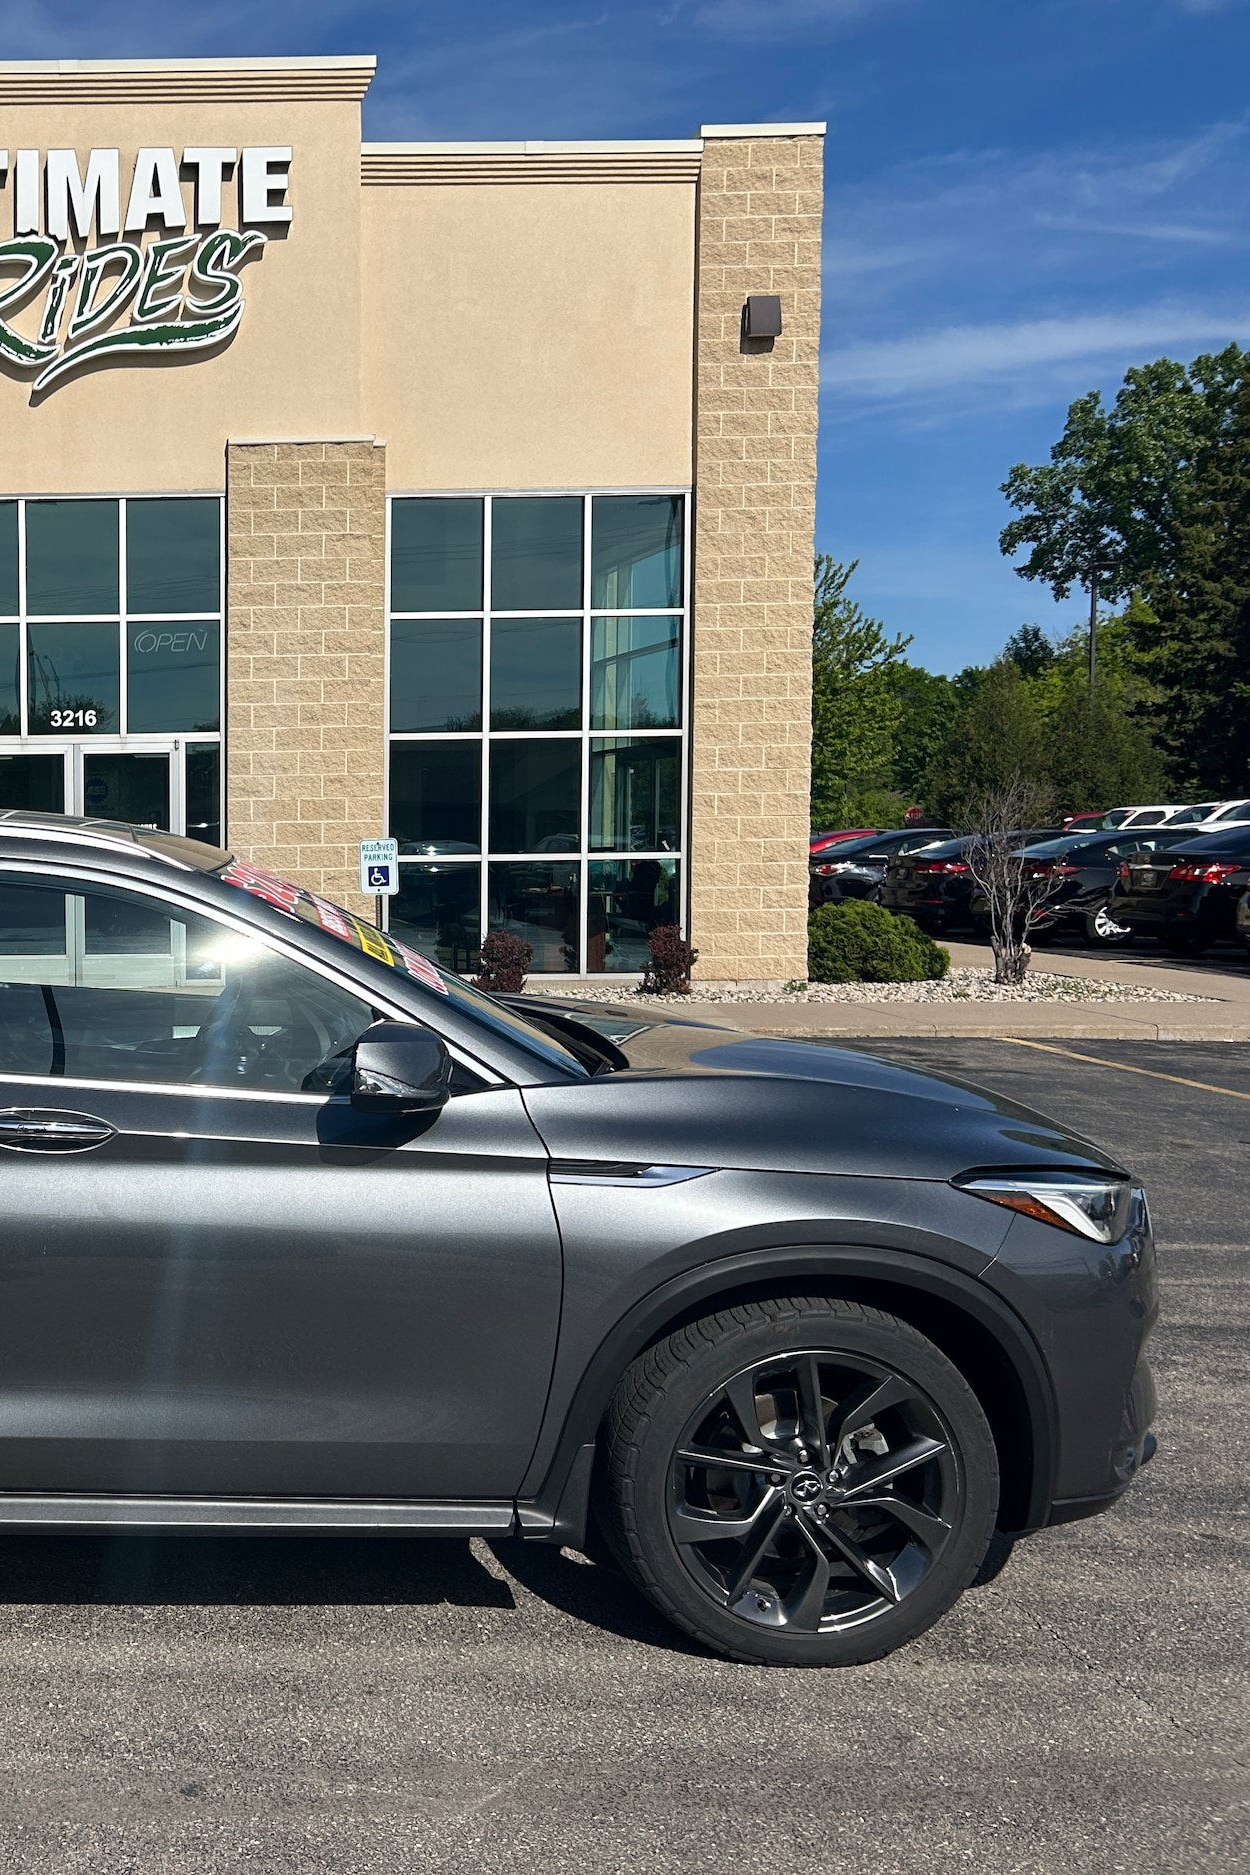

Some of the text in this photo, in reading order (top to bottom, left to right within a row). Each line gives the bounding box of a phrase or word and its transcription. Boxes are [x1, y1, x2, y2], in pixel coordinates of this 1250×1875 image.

[138, 632, 208, 652] OPEN
[50, 710, 97, 727] 3216
[361, 843, 395, 851] RESERVED
[364, 853, 393, 861] PARKING
